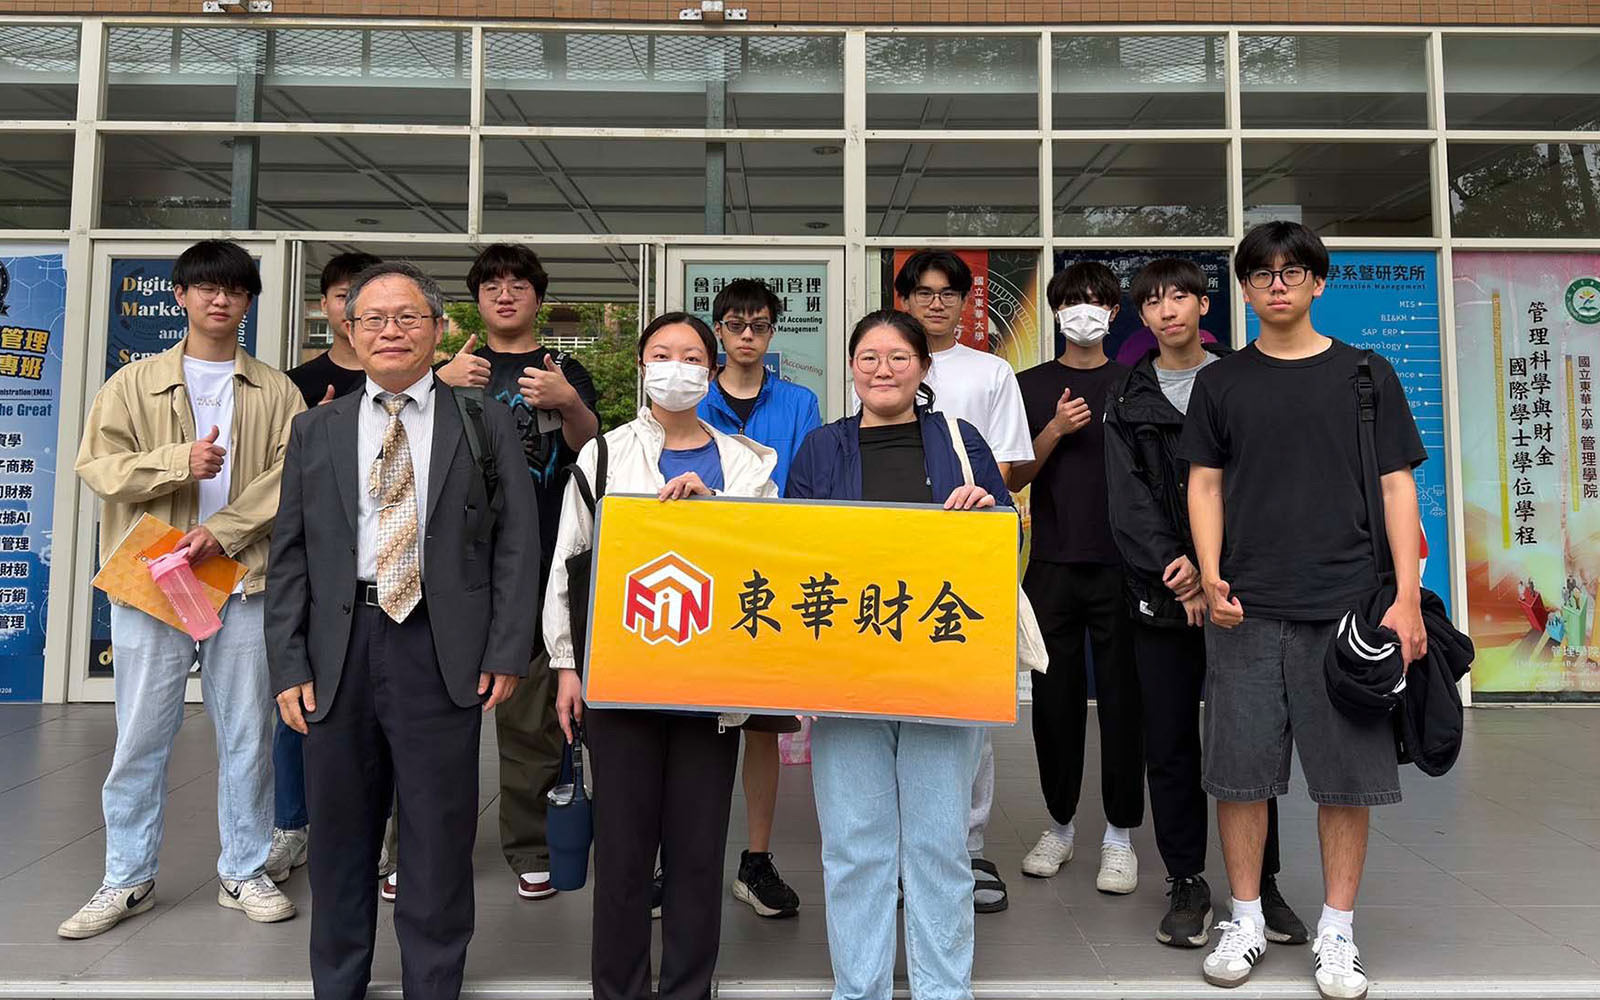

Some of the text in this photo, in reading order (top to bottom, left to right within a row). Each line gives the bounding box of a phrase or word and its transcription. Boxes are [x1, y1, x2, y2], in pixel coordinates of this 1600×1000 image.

[122, 276, 175, 296] Digita
[1374, 283, 1426, 291] Management
[787, 316, 823, 325] Accounting
[777, 325, 819, 334] Management
[1361, 328, 1399, 336] SAP ERP
[1, 326, 50, 353] 管理
[783, 359, 824, 377] Accounting
[1527, 300, 1556, 467] 管理科學與財金
[17, 403, 52, 416] Great
[1577, 355, 1599, 499] 國立東華大學 管理學院
[1509, 357, 1538, 546] 國際學士學位學程
[0, 485, 33, 499] 財務
[0, 511, 31, 525] 據AI
[730, 569, 985, 643] 東華財金
